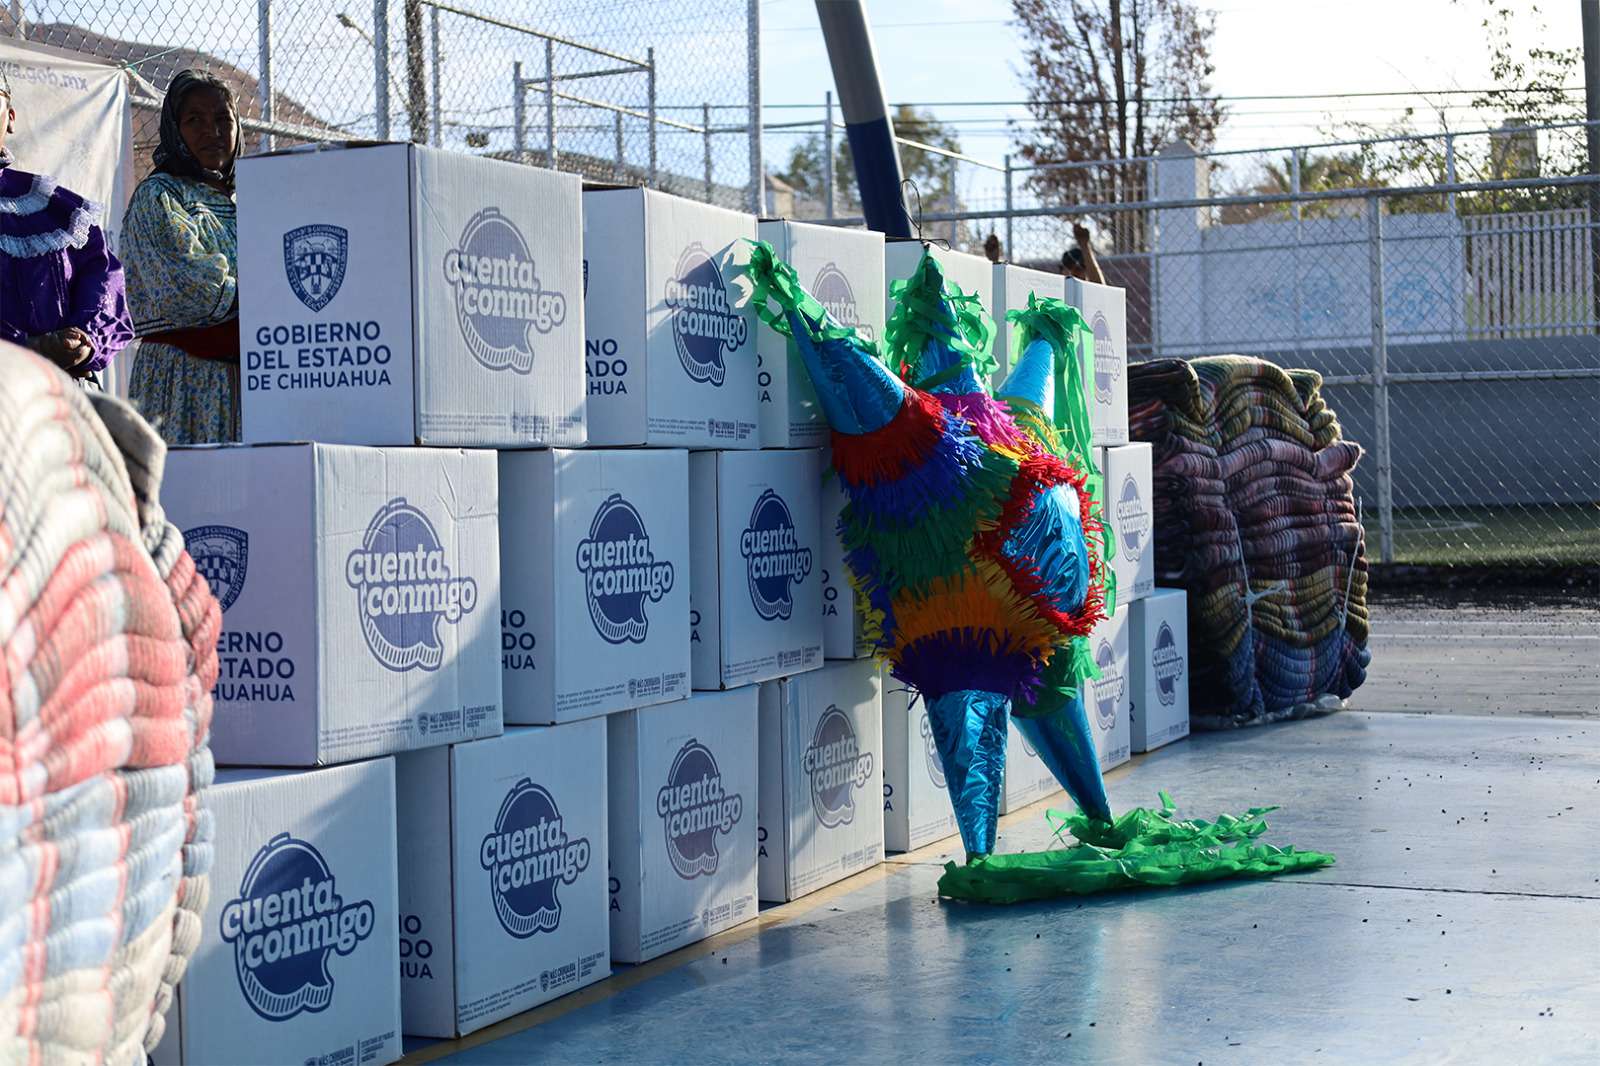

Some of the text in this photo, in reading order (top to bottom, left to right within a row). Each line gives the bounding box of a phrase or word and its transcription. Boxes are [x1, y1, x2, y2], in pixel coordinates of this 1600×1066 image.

[446, 252, 538, 288] cuenta
[464, 287, 565, 329] conmigo
[666, 280, 729, 314] cuenta
[256, 321, 380, 346] GOBIERNO
[678, 310, 747, 347] conmigo
[247, 345, 391, 371] DEL ESTADO
[248, 369, 391, 391] DE CHIHUAHUA
[586, 380, 628, 395] HUA
[578, 533, 652, 569] cuenta
[742, 523, 797, 556] cuenta
[348, 543, 448, 584] cuenta
[592, 563, 673, 599] conmigo
[752, 550, 811, 582] conmigo
[367, 580, 476, 620] conmigo
[219, 658, 295, 679] TADO
[806, 734, 857, 772] cuenta
[816, 753, 872, 792] conmigo
[658, 772, 723, 816] cuenta
[670, 795, 741, 839] conmigo
[482, 816, 565, 866] cuenta
[501, 841, 588, 893] conmigo
[222, 877, 338, 940] cuenta
[246, 904, 372, 969] conmigo
